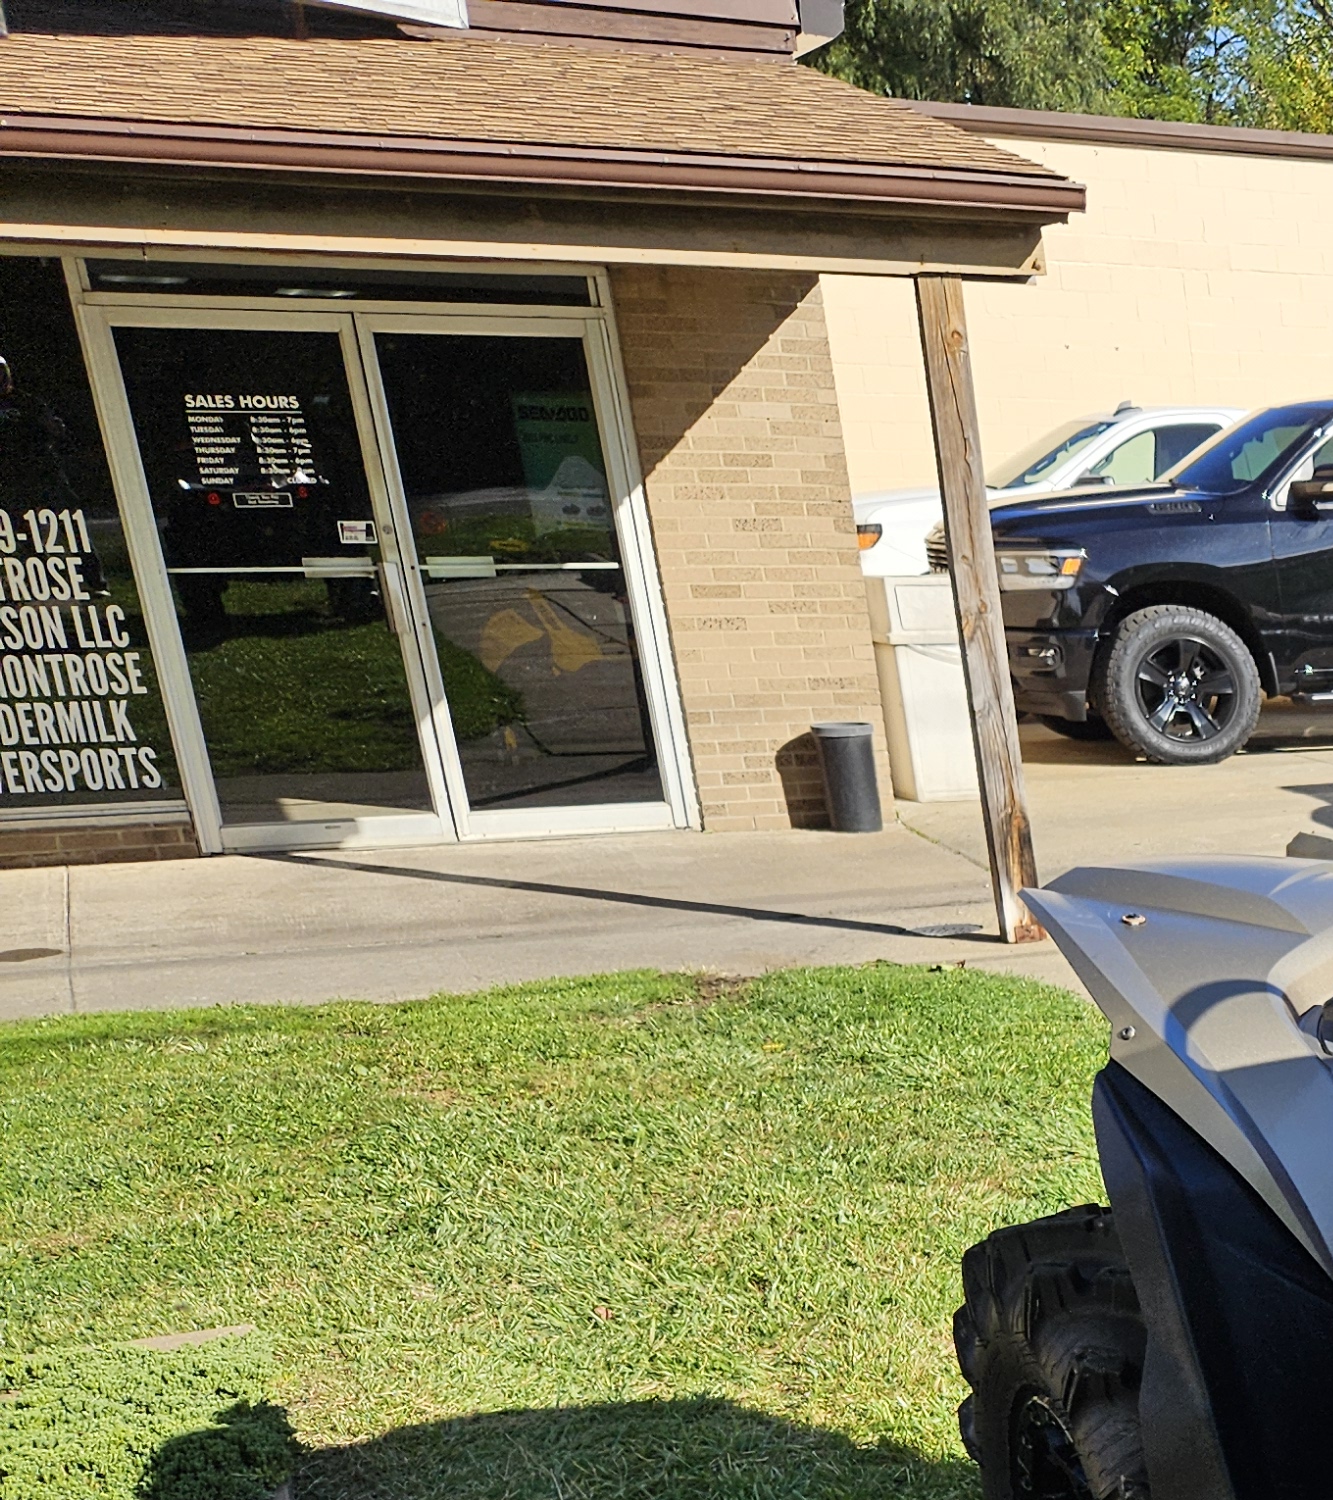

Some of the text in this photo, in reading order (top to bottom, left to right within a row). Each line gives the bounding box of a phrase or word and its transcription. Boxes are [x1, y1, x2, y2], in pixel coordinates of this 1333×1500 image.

[184, 394, 300, 409] SALES HOURS
[192, 436, 241, 444] WEDNESDAY
[197, 456, 224, 464] FRIDAY
[201, 477, 234, 485] SUNDAY
[0, 605, 129, 649] SON LLC
[0, 652, 147, 698] ONTROSE
[0, 747, 162, 793] ERSPORTS
